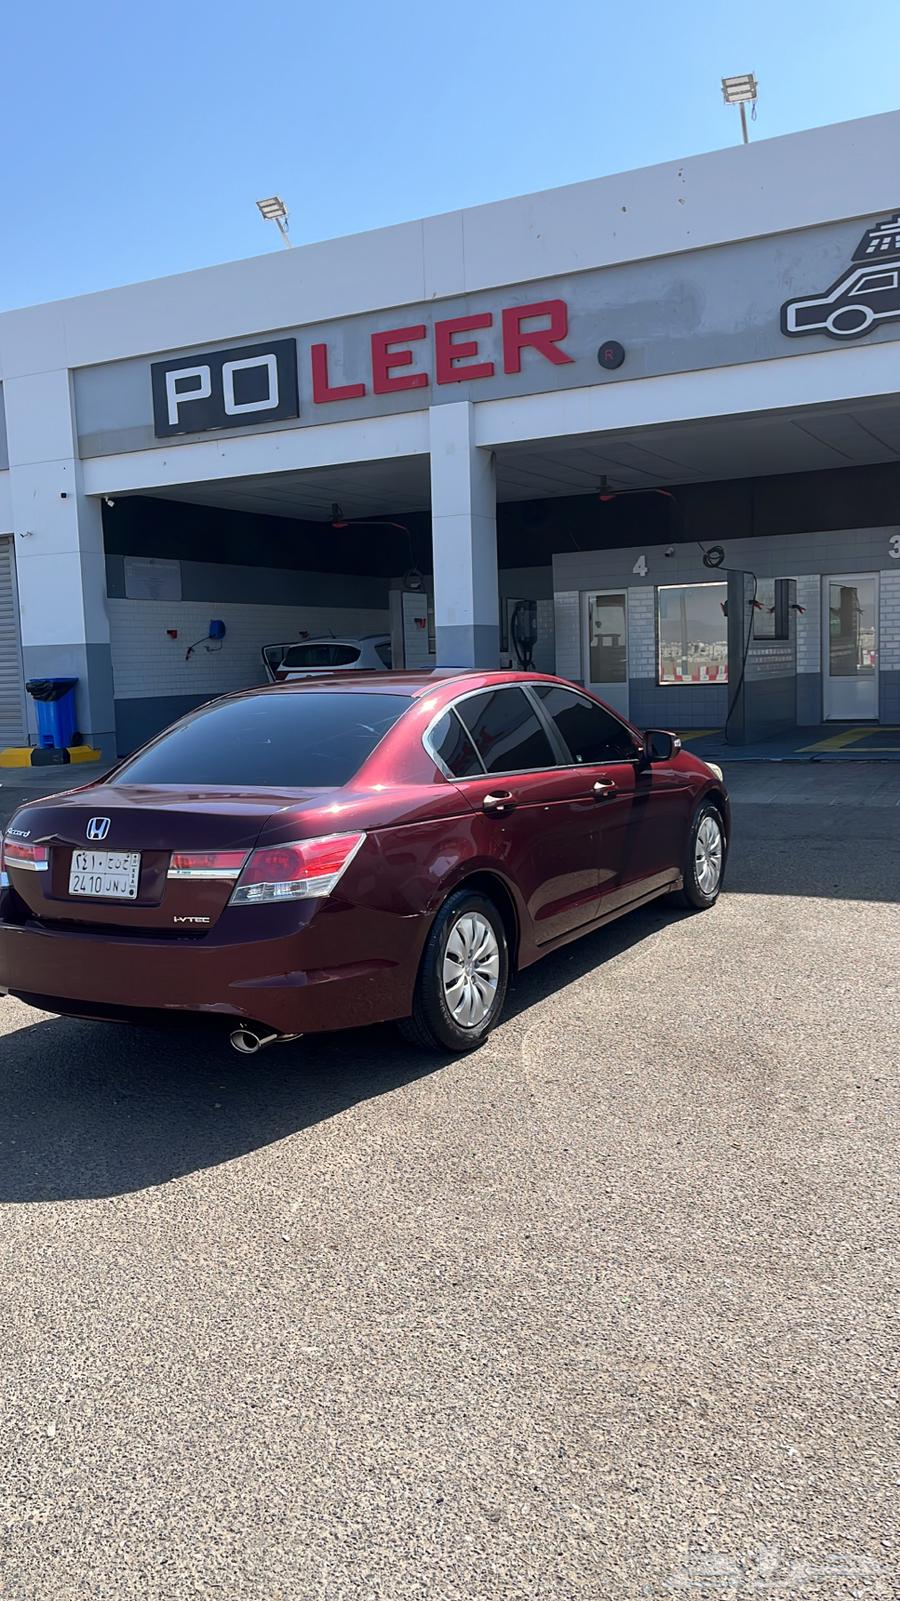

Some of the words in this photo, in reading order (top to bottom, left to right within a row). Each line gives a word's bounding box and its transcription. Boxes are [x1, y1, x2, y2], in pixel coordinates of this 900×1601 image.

[632, 555, 648, 577] 4
[6, 827, 31, 838] Accord
[73, 875, 102, 893] 2410
